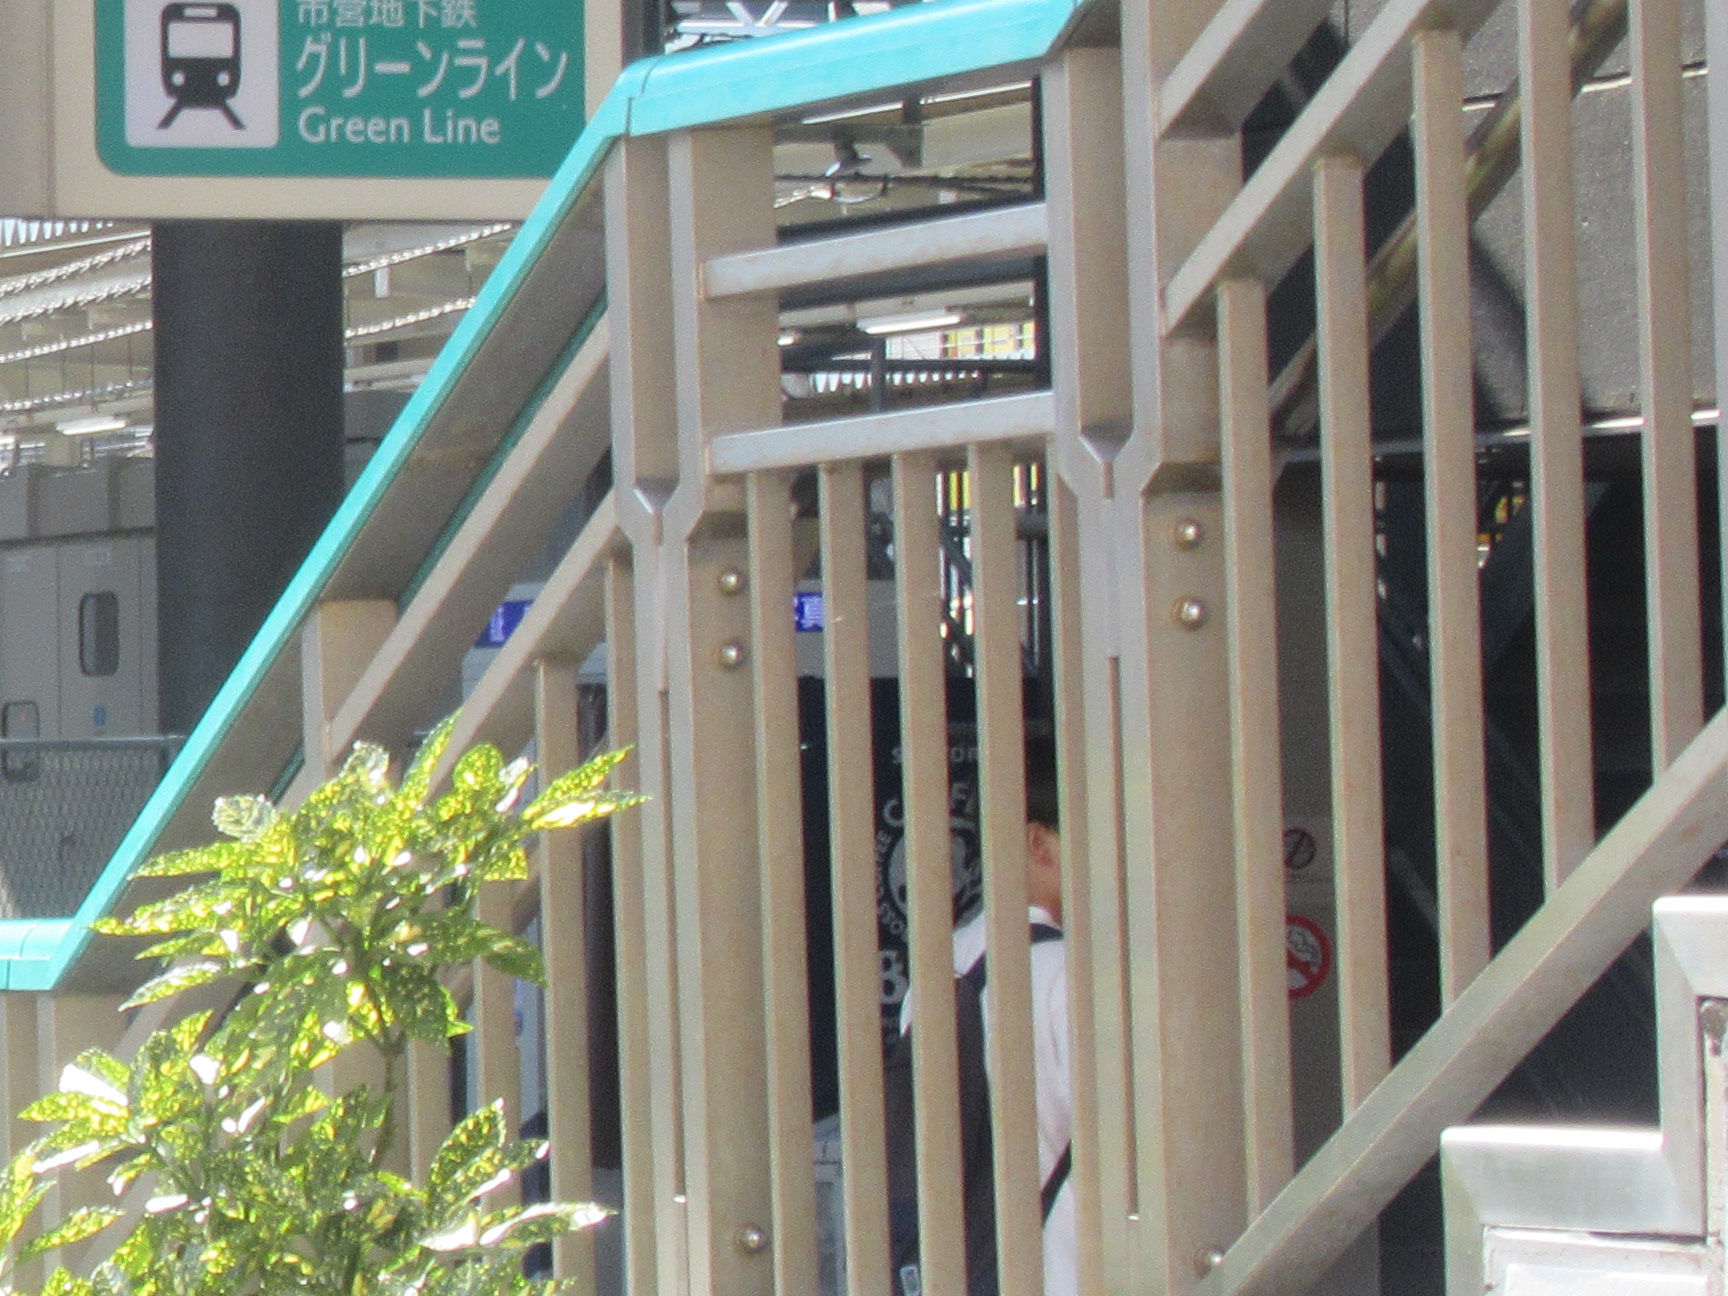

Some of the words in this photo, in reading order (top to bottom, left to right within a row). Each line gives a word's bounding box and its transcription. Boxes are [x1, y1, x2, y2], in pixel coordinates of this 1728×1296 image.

[296, 32, 569, 100] グリーンライン
[298, 106, 410, 144] Green
[424, 108, 501, 144] Line
